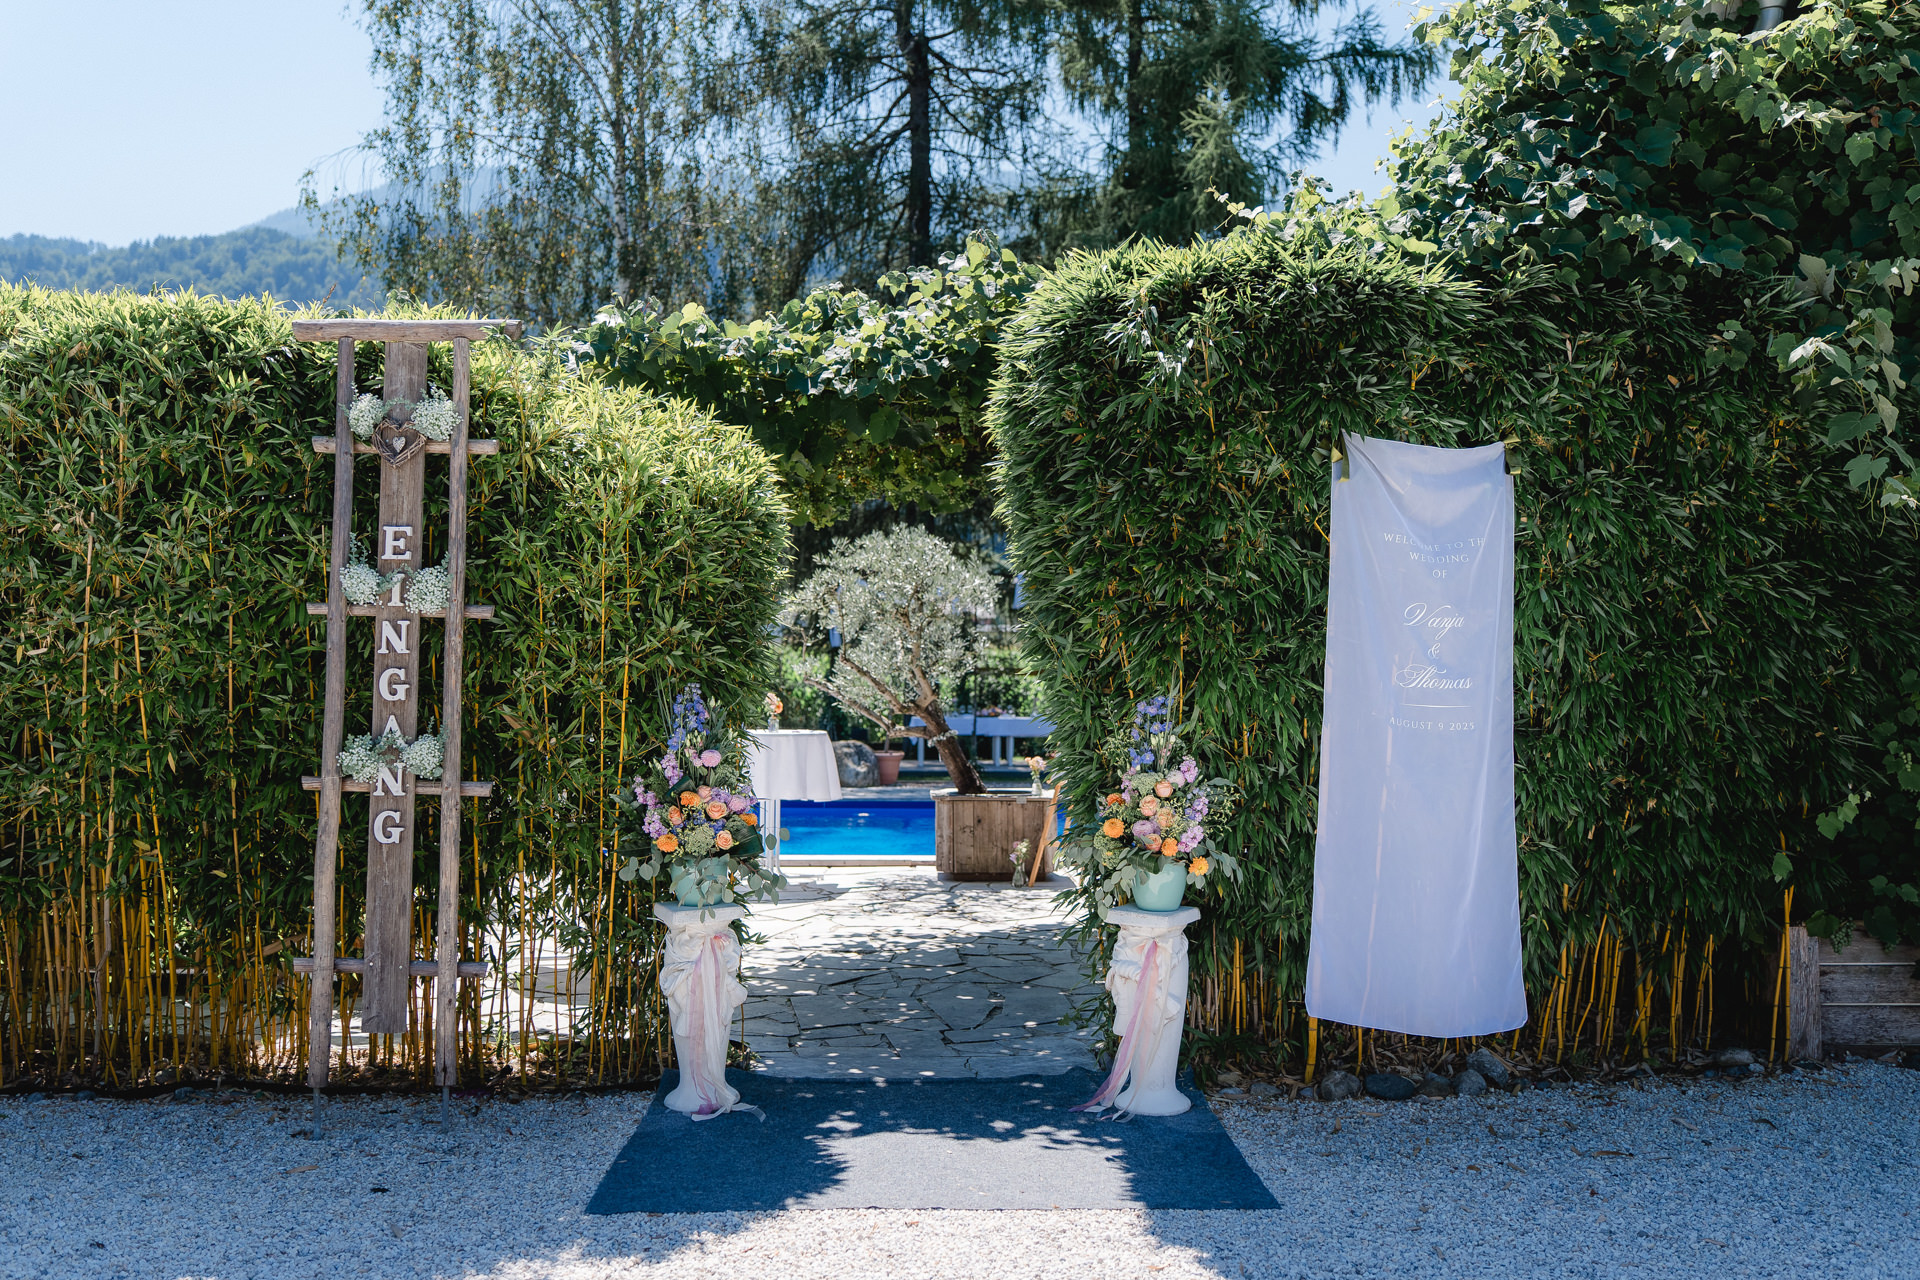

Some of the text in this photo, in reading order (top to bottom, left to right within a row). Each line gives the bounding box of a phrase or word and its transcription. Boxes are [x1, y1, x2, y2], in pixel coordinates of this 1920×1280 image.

[1446, 541, 1464, 550] TO
[1468, 537, 1486, 547] TH
[1409, 551, 1469, 564] WEDDING
[1432, 569, 1448, 579] OF
[1403, 602, 1465, 641] Vanja
[1427, 642, 1441, 659] &
[1394, 663, 1473, 689] Thomas
[373, 525, 413, 844] EINGANG
[1389, 716, 1476, 731] AUGUST 9 2025
